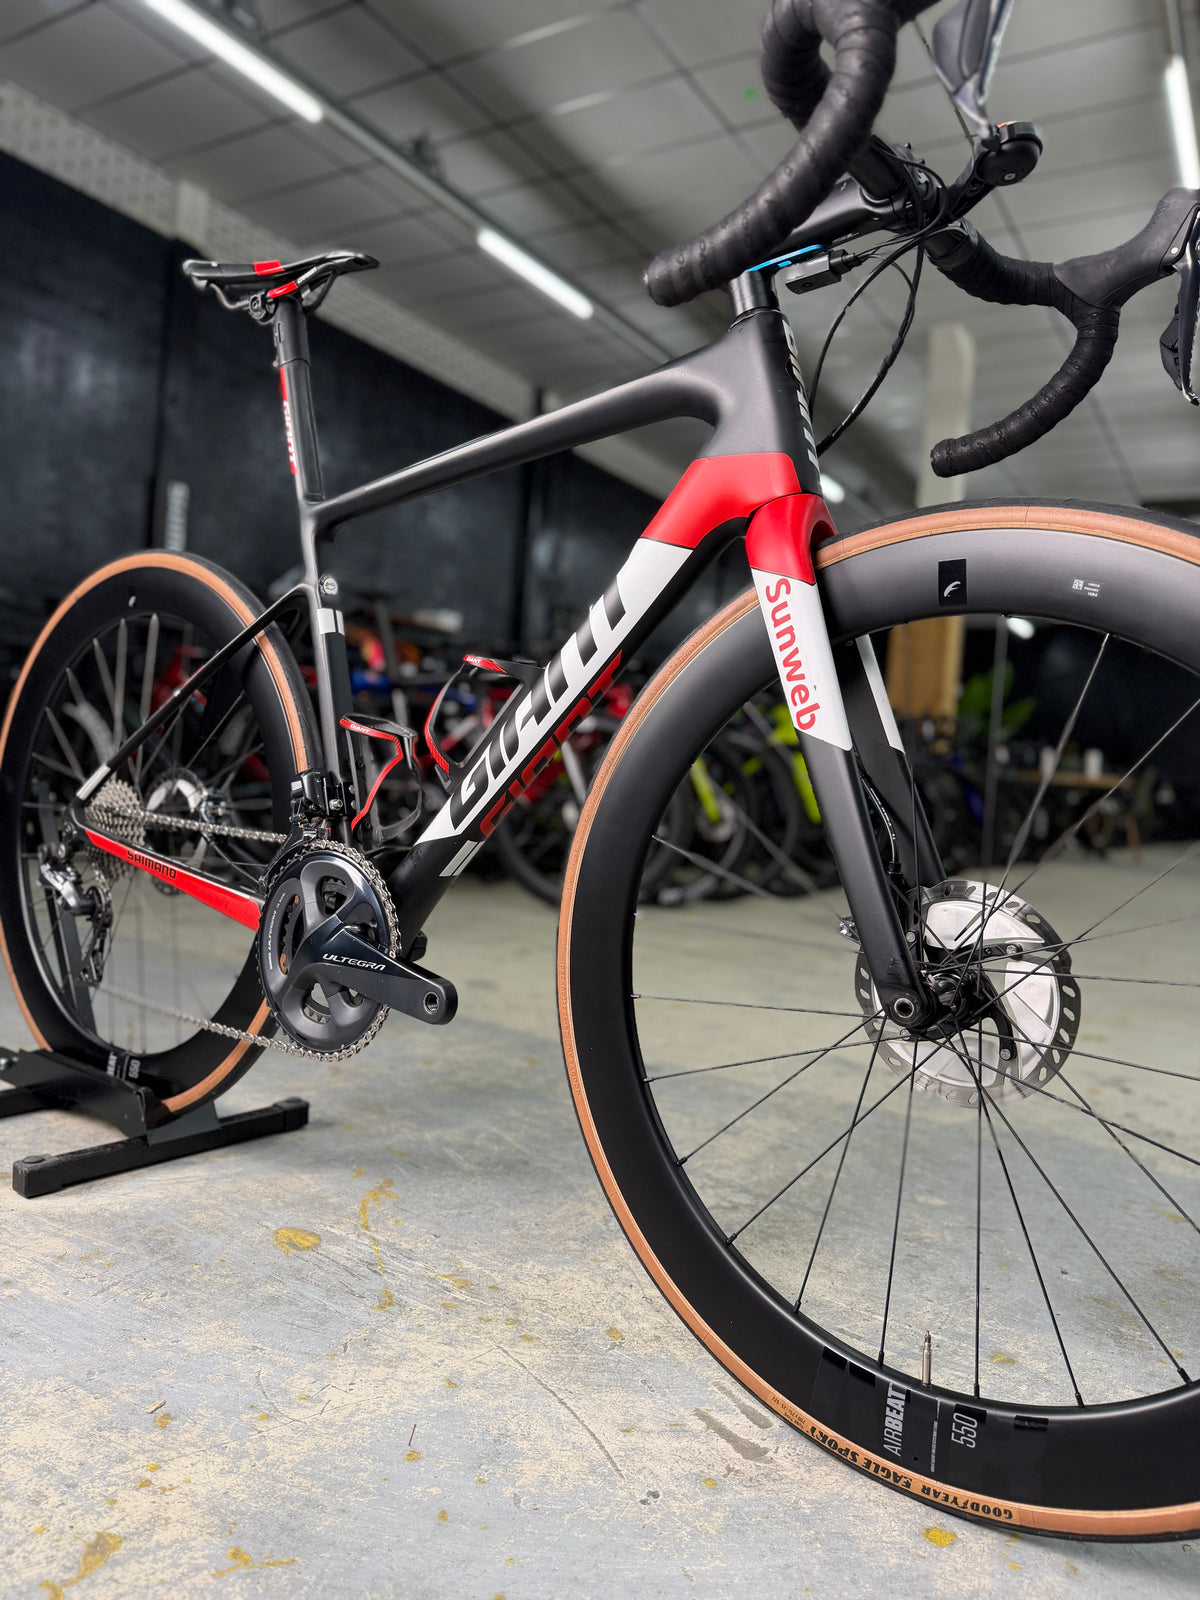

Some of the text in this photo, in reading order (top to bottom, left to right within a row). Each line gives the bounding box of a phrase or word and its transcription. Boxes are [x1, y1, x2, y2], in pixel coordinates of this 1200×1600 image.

[766, 578, 820, 730] Sunweb
[350, 723, 370, 733] GIANT
[127, 851, 176, 879] SHIMANO
[322, 953, 386, 971] ULTEGRA
[883, 1382, 906, 1457] AIRBEAT
[951, 1412, 978, 1449] 550
[806, 1426, 860, 1463] SPORT
[861, 1457, 913, 1490] EAGLE
